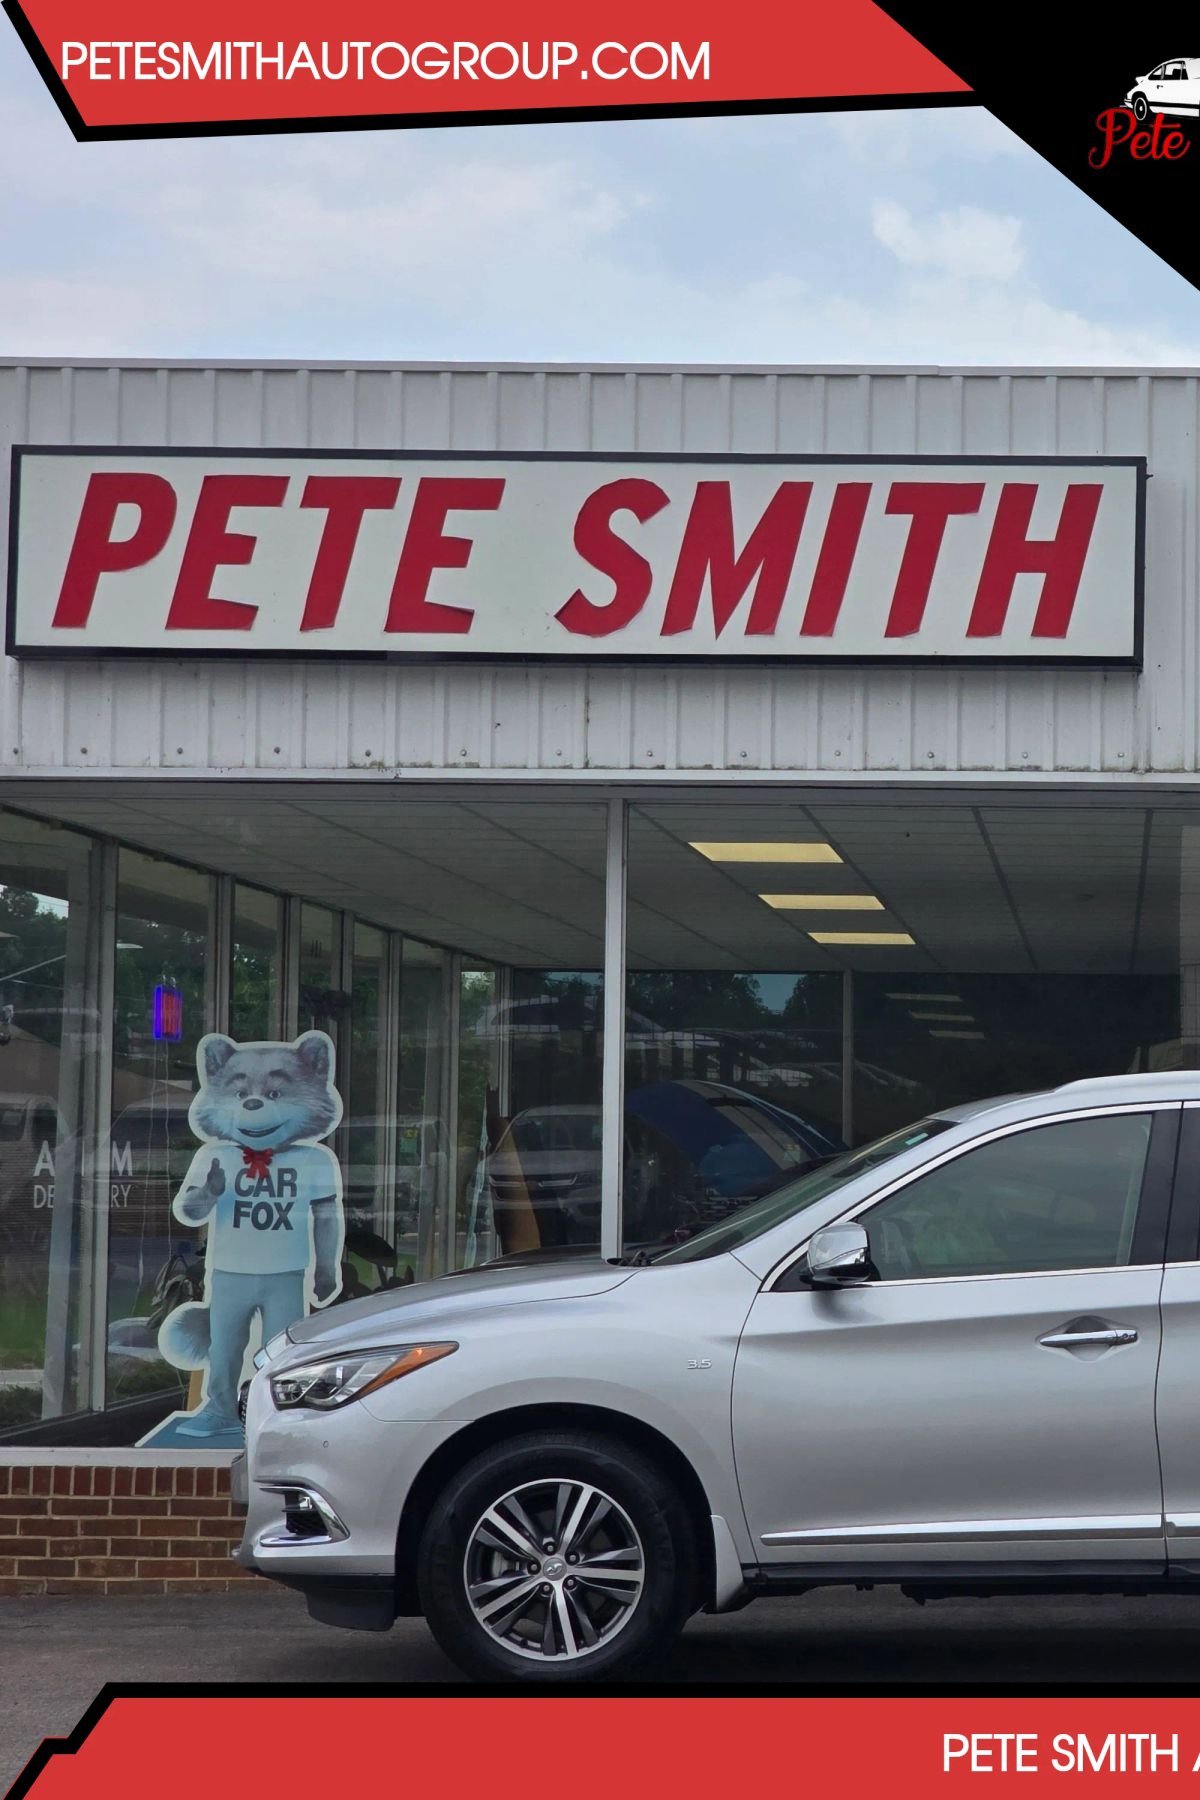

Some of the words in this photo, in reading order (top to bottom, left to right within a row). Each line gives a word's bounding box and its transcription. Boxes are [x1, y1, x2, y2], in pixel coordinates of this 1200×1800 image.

[51, 472, 506, 634] PETE
[554, 477, 1104, 640] SMITH
[234, 1168, 298, 1198] CAR
[233, 1201, 295, 1231] FOX
[687, 1359, 712, 1369] 3.5
